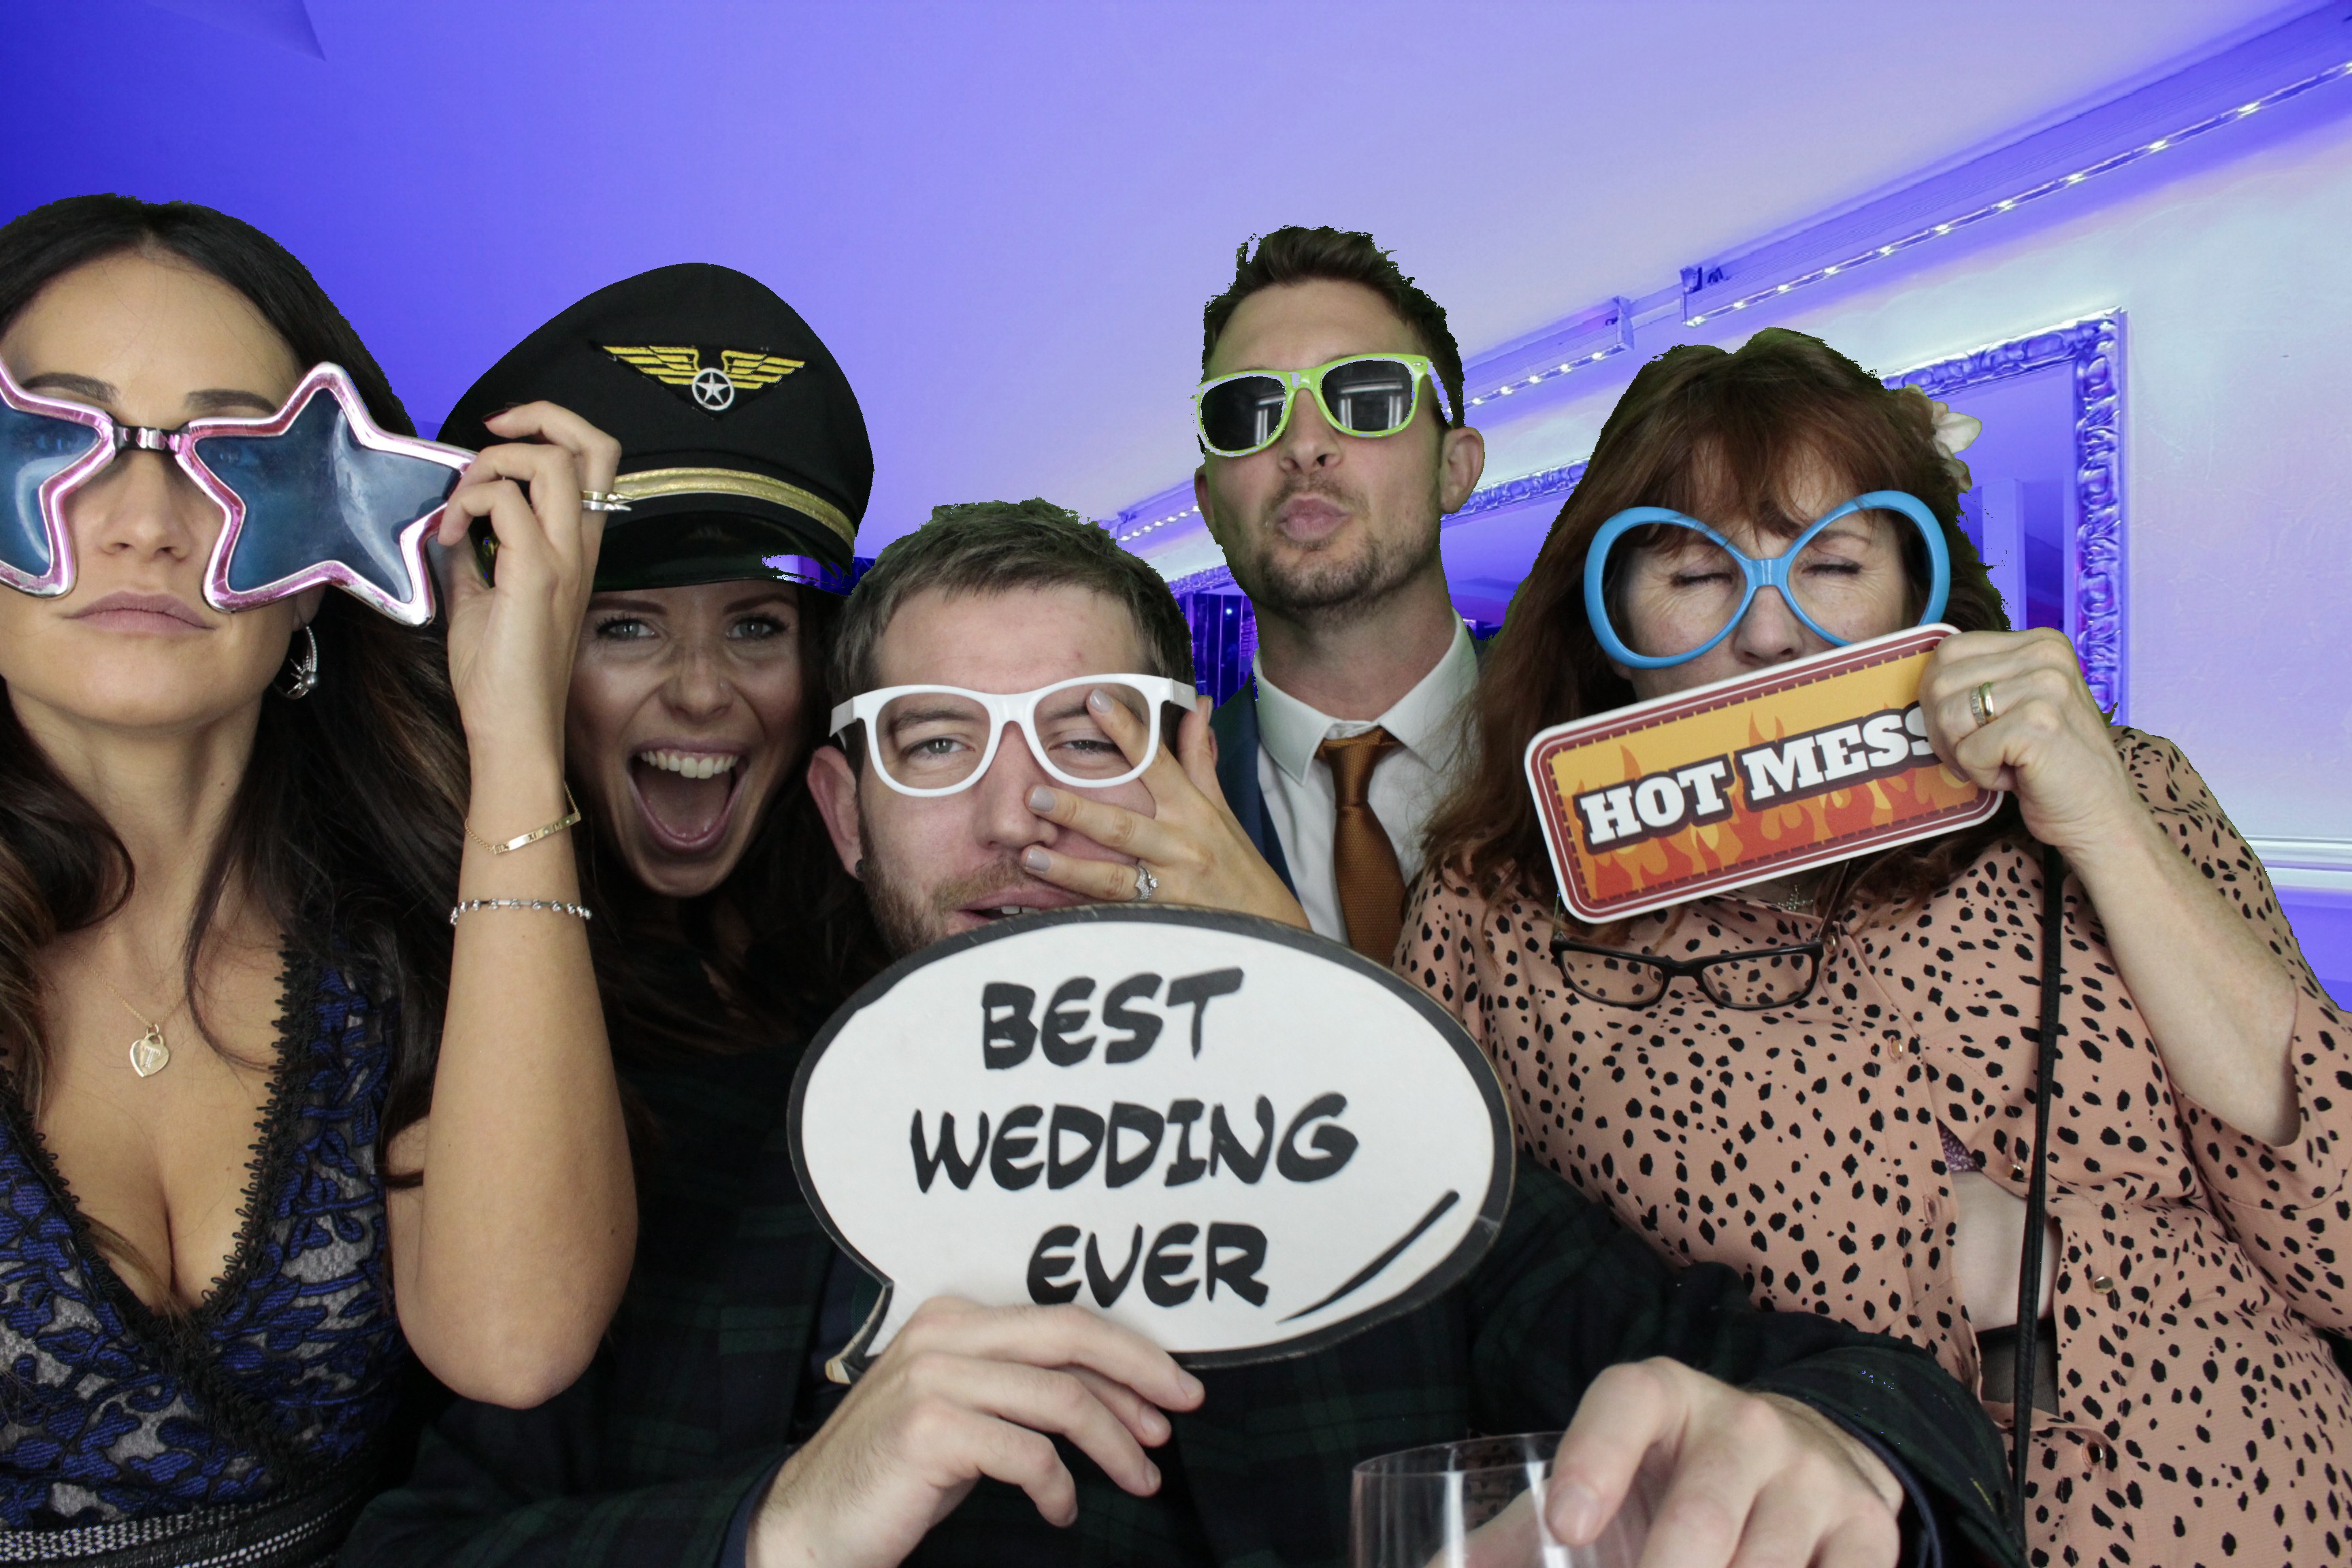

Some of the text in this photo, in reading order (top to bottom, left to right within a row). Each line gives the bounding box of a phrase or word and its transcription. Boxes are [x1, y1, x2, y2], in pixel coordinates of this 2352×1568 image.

[1581, 760, 1726, 844] HOT
[981, 966, 1244, 1071] BEST
[910, 1092, 1359, 1194] WEDDING
[1026, 1221, 1270, 1309] EVER
